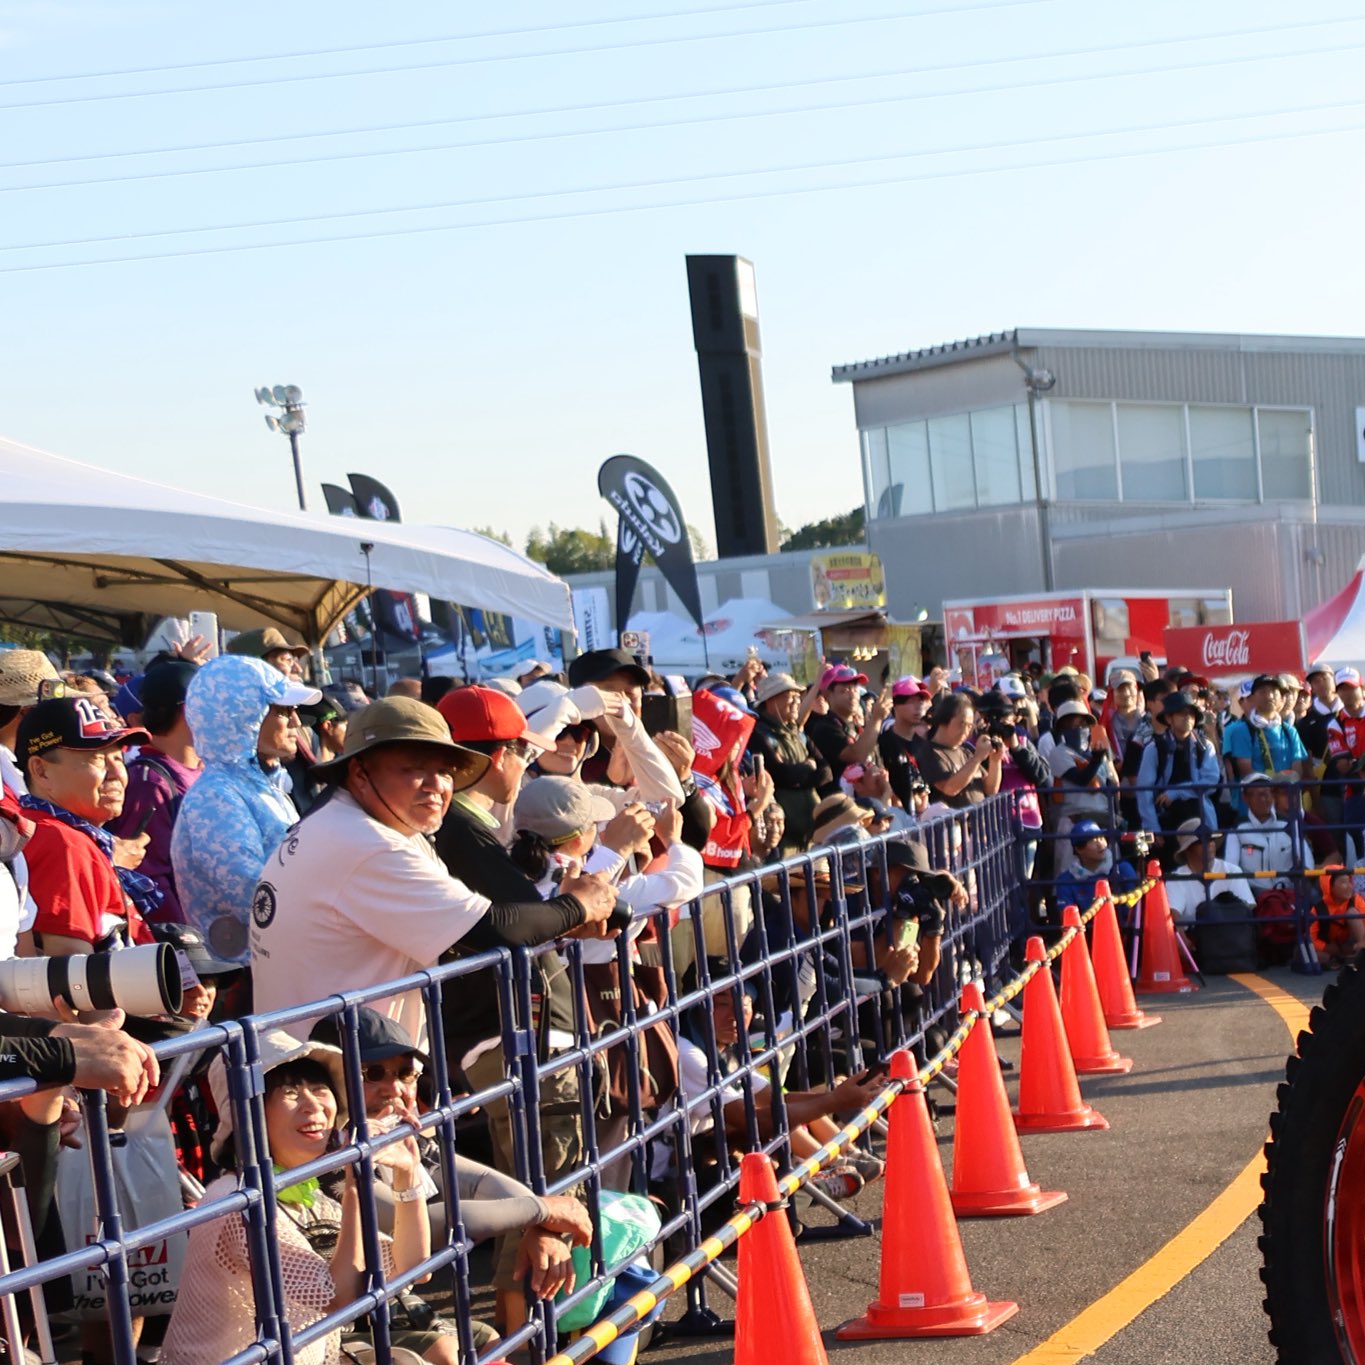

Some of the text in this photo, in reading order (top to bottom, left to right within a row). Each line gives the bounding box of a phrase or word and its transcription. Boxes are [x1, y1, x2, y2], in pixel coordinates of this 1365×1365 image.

[1023, 608, 1053, 623] DELIVERY
[1055, 606, 1076, 621] PIZZA
[131, 1268, 170, 1288] Got
